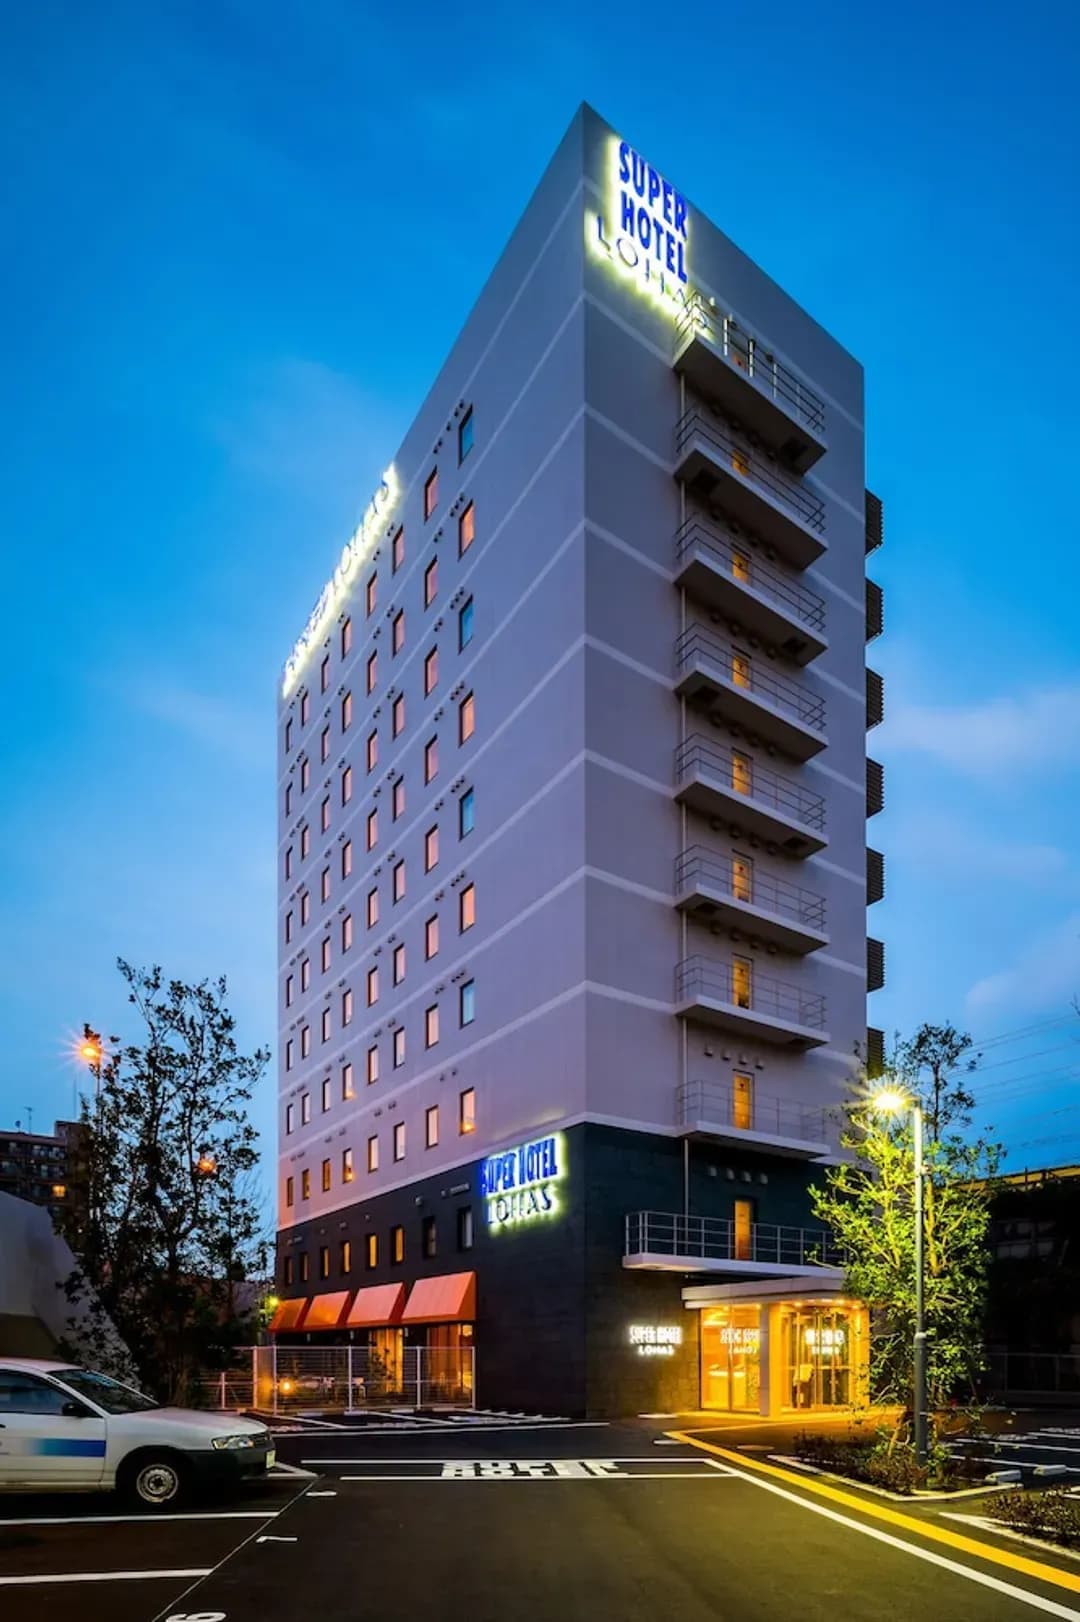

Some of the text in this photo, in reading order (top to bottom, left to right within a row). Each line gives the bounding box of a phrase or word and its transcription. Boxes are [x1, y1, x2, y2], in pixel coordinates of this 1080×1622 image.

[619, 141, 688, 241] SUPER
[621, 190, 688, 284] HOTEL
[480, 1138, 558, 1198] SUPER HOTEL
[486, 1183, 553, 1225] LOHAS
